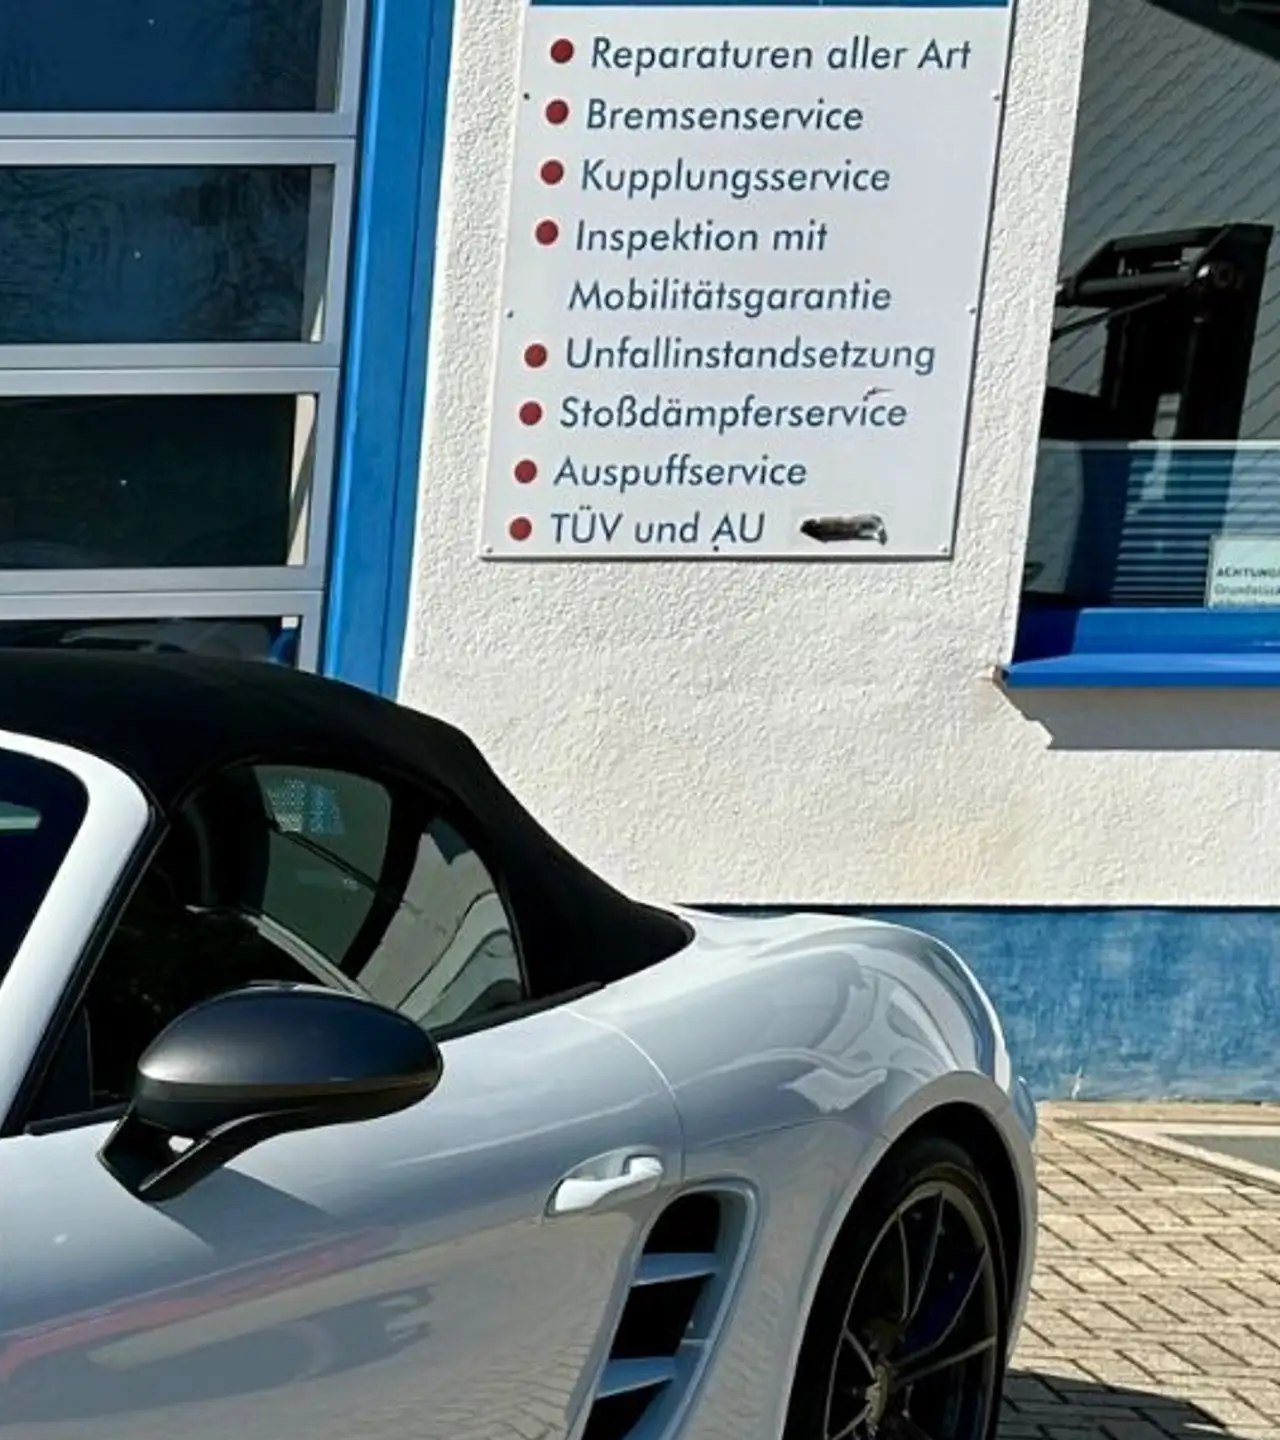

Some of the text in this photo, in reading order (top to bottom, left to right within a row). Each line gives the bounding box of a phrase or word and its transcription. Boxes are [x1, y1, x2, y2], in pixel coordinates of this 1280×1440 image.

[591, 36, 971, 76] Reparaturen aller Art
[587, 98, 864, 131] Bremsenservice
[581, 158, 891, 199] Kupplungsservice
[576, 219, 827, 258] Inspektion mit
[568, 278, 892, 318] Mobilitätsgarantie
[566, 336, 936, 376] Unfallinstandsetzung
[560, 394, 908, 434] Stoßdämpferservice
[553, 455, 807, 492] Auspuffservice
[551, 506, 765, 544] TÜV und AU
